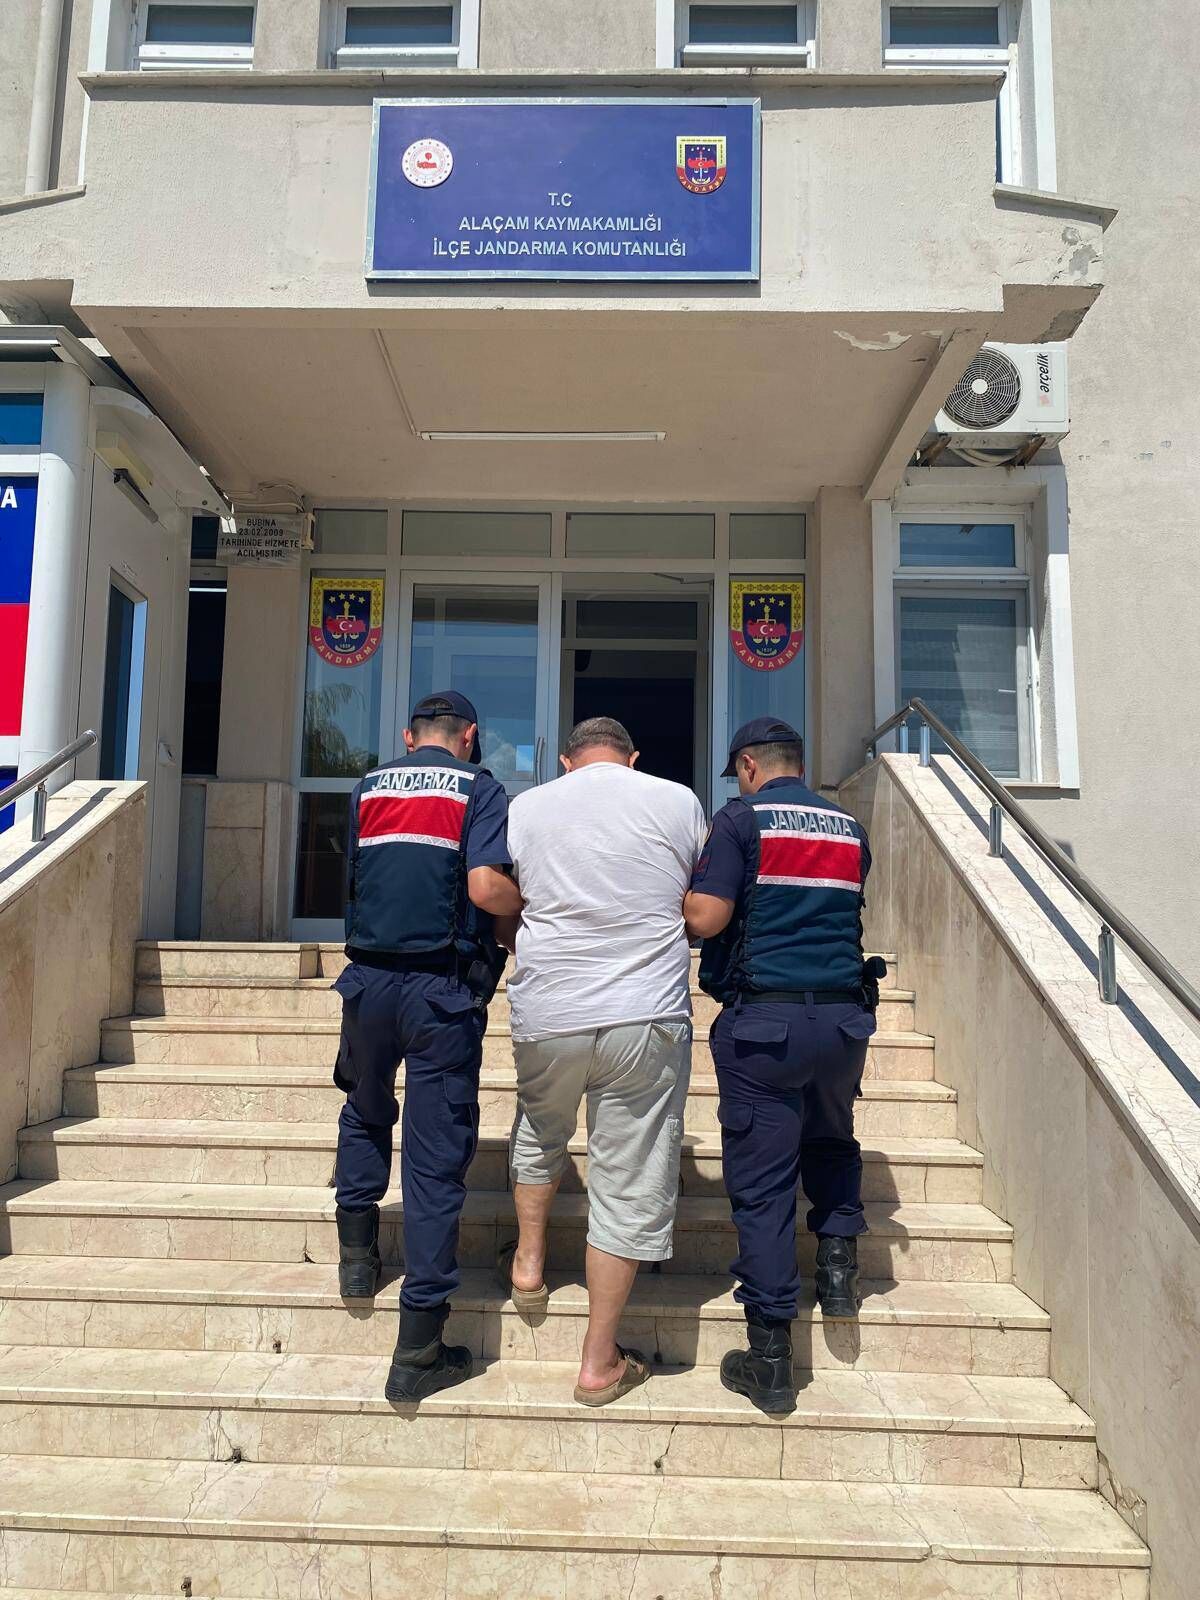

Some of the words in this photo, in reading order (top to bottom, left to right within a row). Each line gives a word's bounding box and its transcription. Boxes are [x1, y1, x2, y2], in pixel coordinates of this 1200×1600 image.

[548, 192, 573, 207] T.C
[458, 216, 530, 234] ALAÇAM
[534, 213, 662, 232] KAYMAKAMLIĞI
[433, 237, 471, 259] İLÇE
[474, 240, 568, 256] JANDARMA
[572, 238, 686, 257] KOMUTANLIĞI
[1036, 353, 1052, 393] arçelik
[314, 635, 378, 665] JANDARMA
[735, 640, 800, 668] JANDARMA
[371, 772, 460, 793] JANDARMA
[769, 810, 854, 837] JANDARMA
